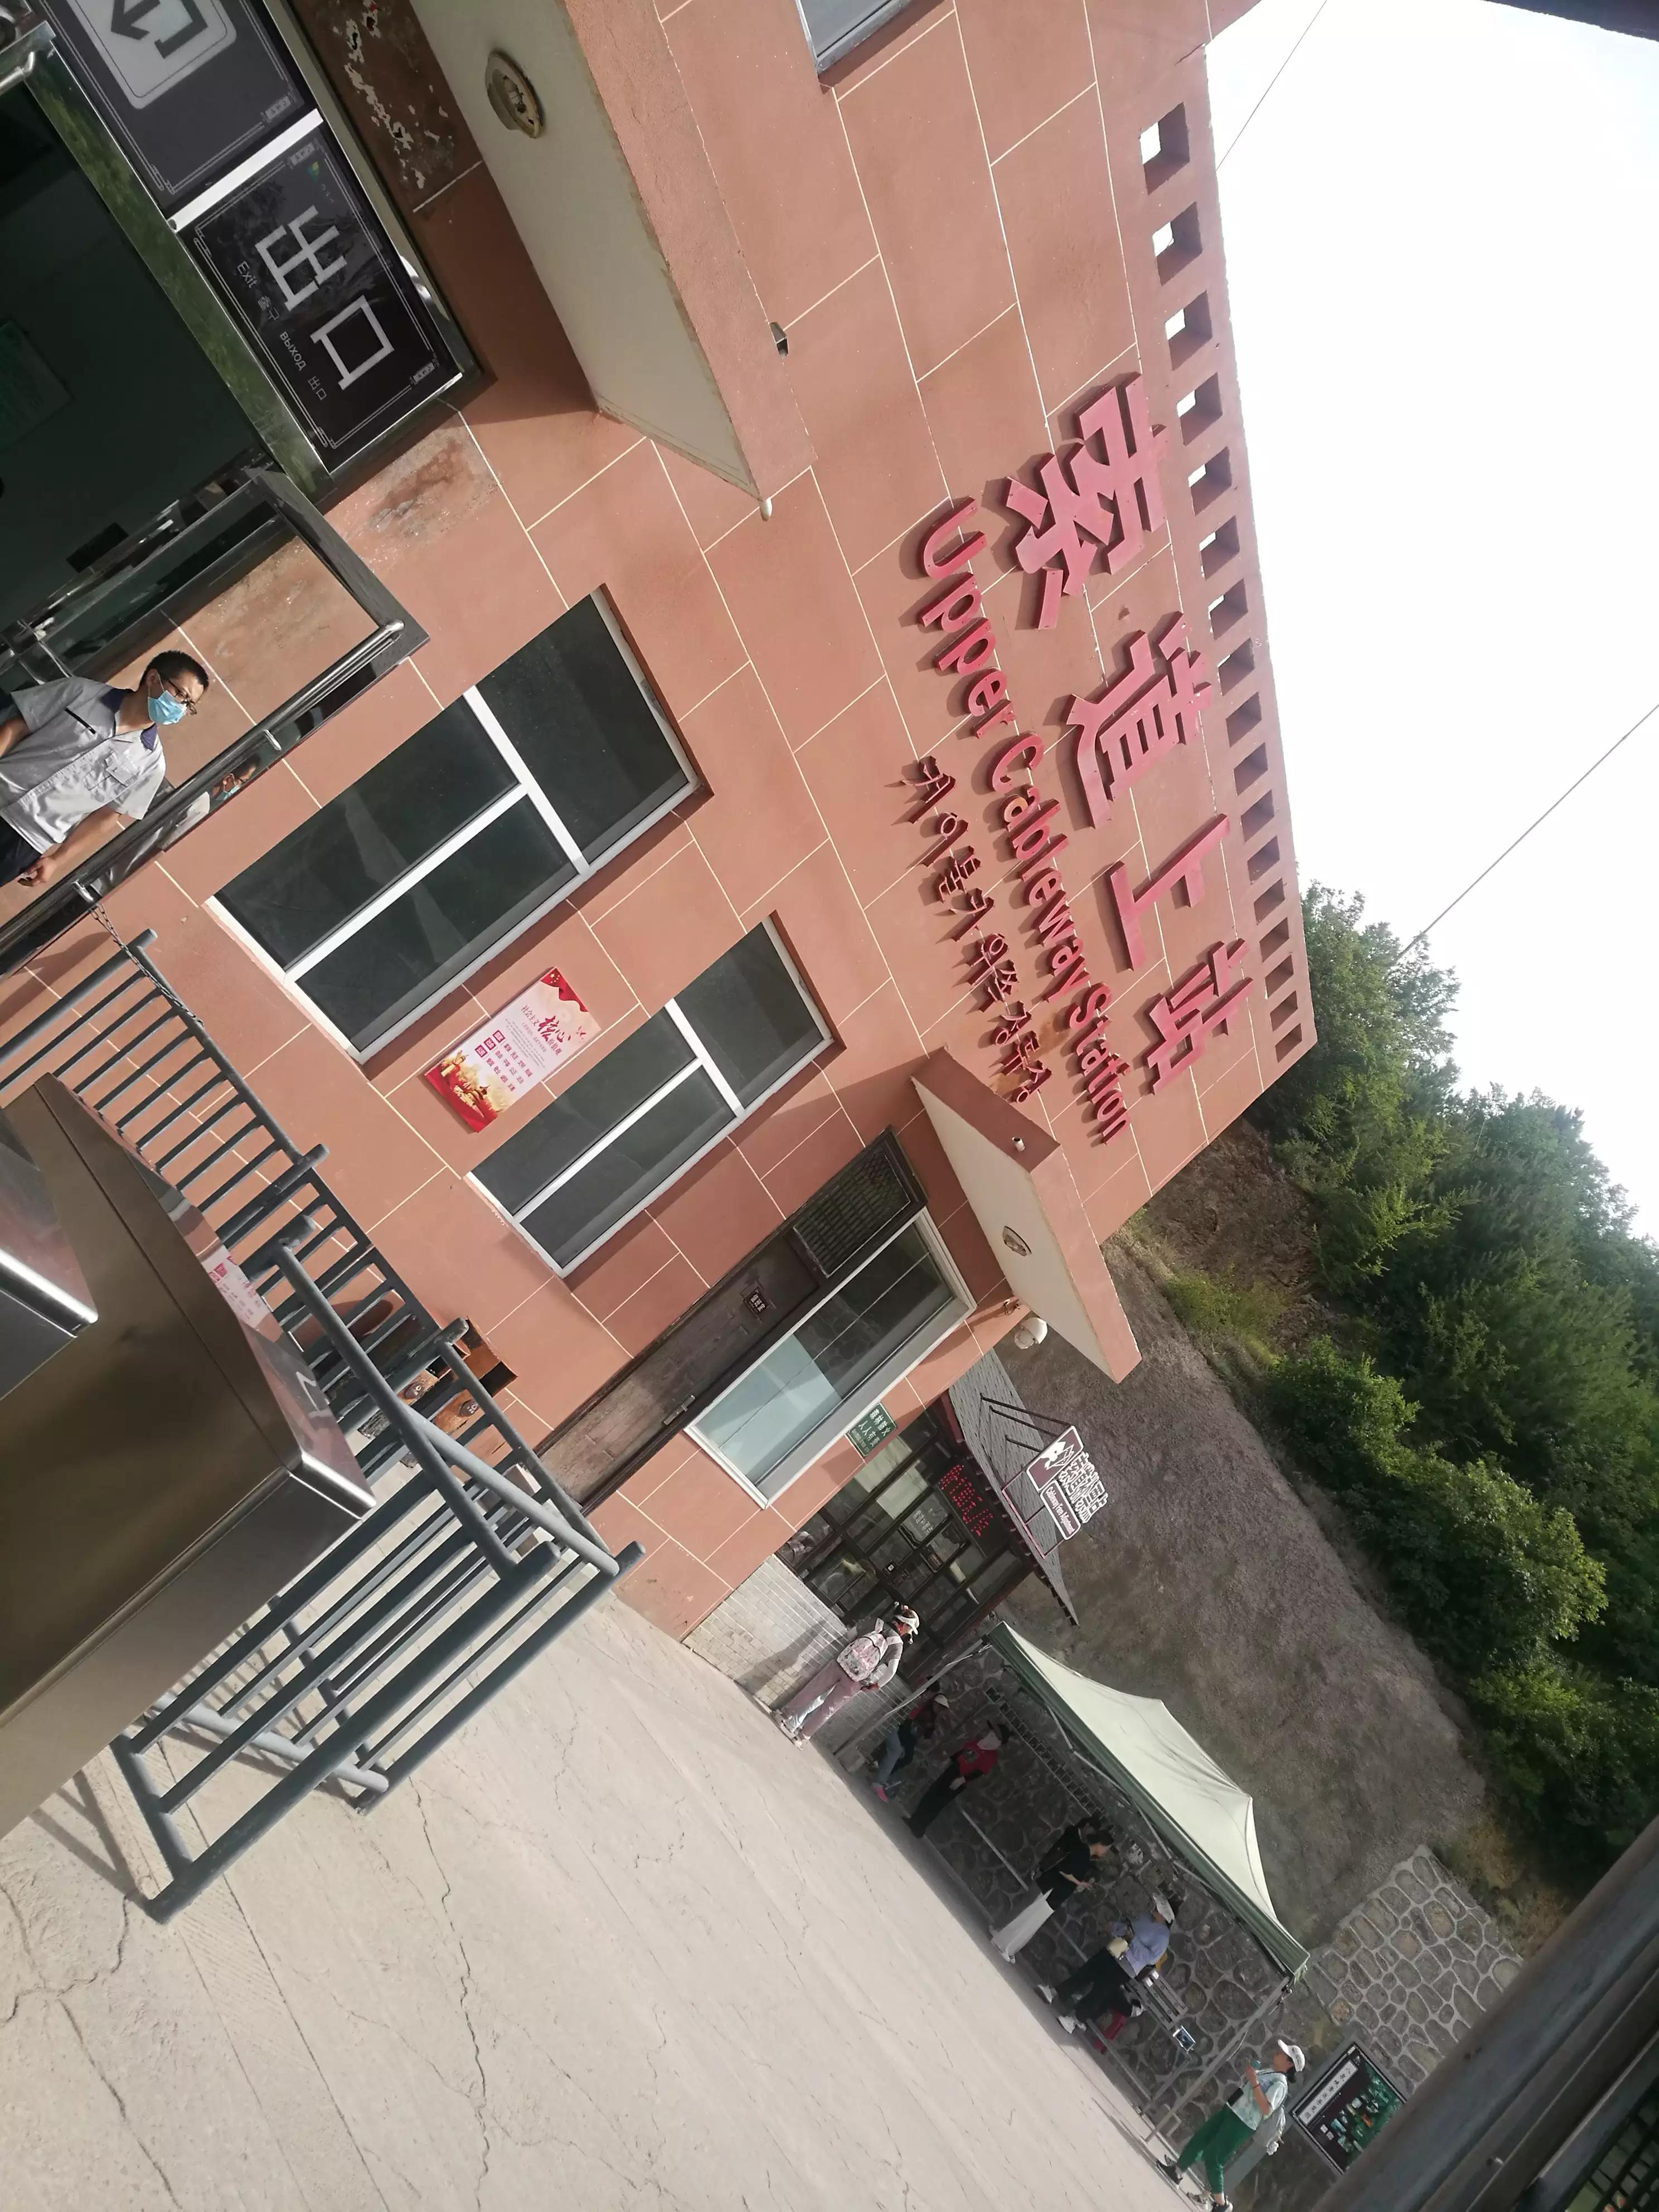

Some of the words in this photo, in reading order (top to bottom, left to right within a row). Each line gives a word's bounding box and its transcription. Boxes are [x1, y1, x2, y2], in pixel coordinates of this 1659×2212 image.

[236, 261, 258, 289] Exit
[255, 205, 395, 390] 出口
[258, 295, 279, 321] 출구
[279, 331, 307, 371] выход
[307, 375, 327, 401] 出口
[1005, 371, 1254, 1097] 索道上站
[900, 755, 995, 942] 케이블카
[919, 496, 1017, 739] Upper
[988, 729, 1090, 1003] Cableway
[1067, 981, 1131, 1146] Station
[966, 933, 1020, 1013] 위쪽
[990, 1000, 1053, 1104] 정류장
[858, 1420, 880, 1447] 人人有责
[870, 1408, 891, 1437] 森林防火
[1046, 1486, 1059, 1508] Cableway
[1058, 1451, 1108, 1524] 索道补票点
